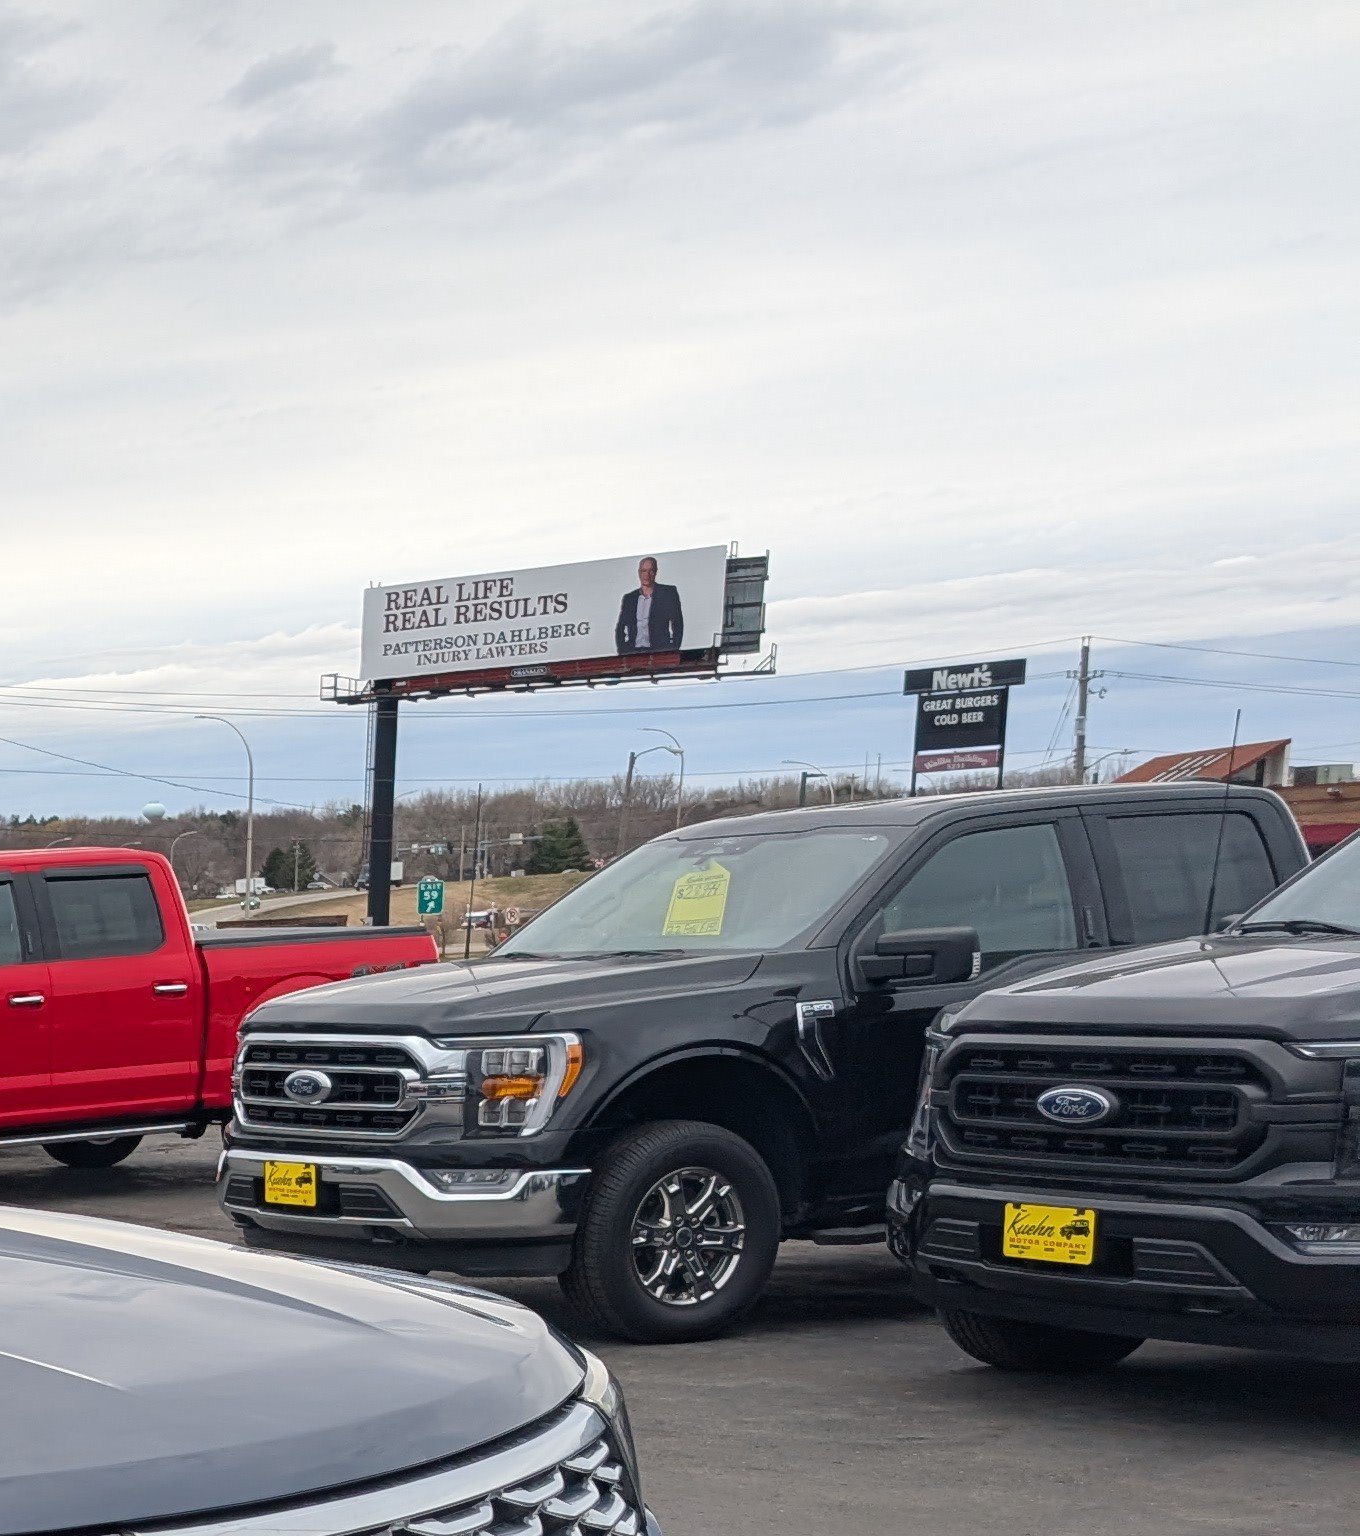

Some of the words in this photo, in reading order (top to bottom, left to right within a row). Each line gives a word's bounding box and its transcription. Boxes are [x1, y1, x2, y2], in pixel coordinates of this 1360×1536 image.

[385, 585, 449, 612] REAL
[455, 577, 515, 603] LIFE
[383, 607, 447, 634] REAL
[454, 593, 569, 626] RESULTS
[382, 633, 478, 657] PATTERSON
[482, 622, 591, 647] DAHLBERG
[416, 648, 471, 667] INJURY
[474, 641, 549, 662] LAWYERS
[931, 664, 993, 691] Newt's
[922, 698, 953, 712] GREAT
[954, 694, 999, 709] BURGERS
[934, 713, 959, 726] COLD
[961, 711, 984, 724] BEER
[420, 883, 442, 891] EXIT
[423, 890, 438, 901] 59
[1052, 1095, 1091, 1117] Ford
[1006, 1212, 1056, 1238] Kuehn
[1042, 1240, 1087, 1250] COMPANY
